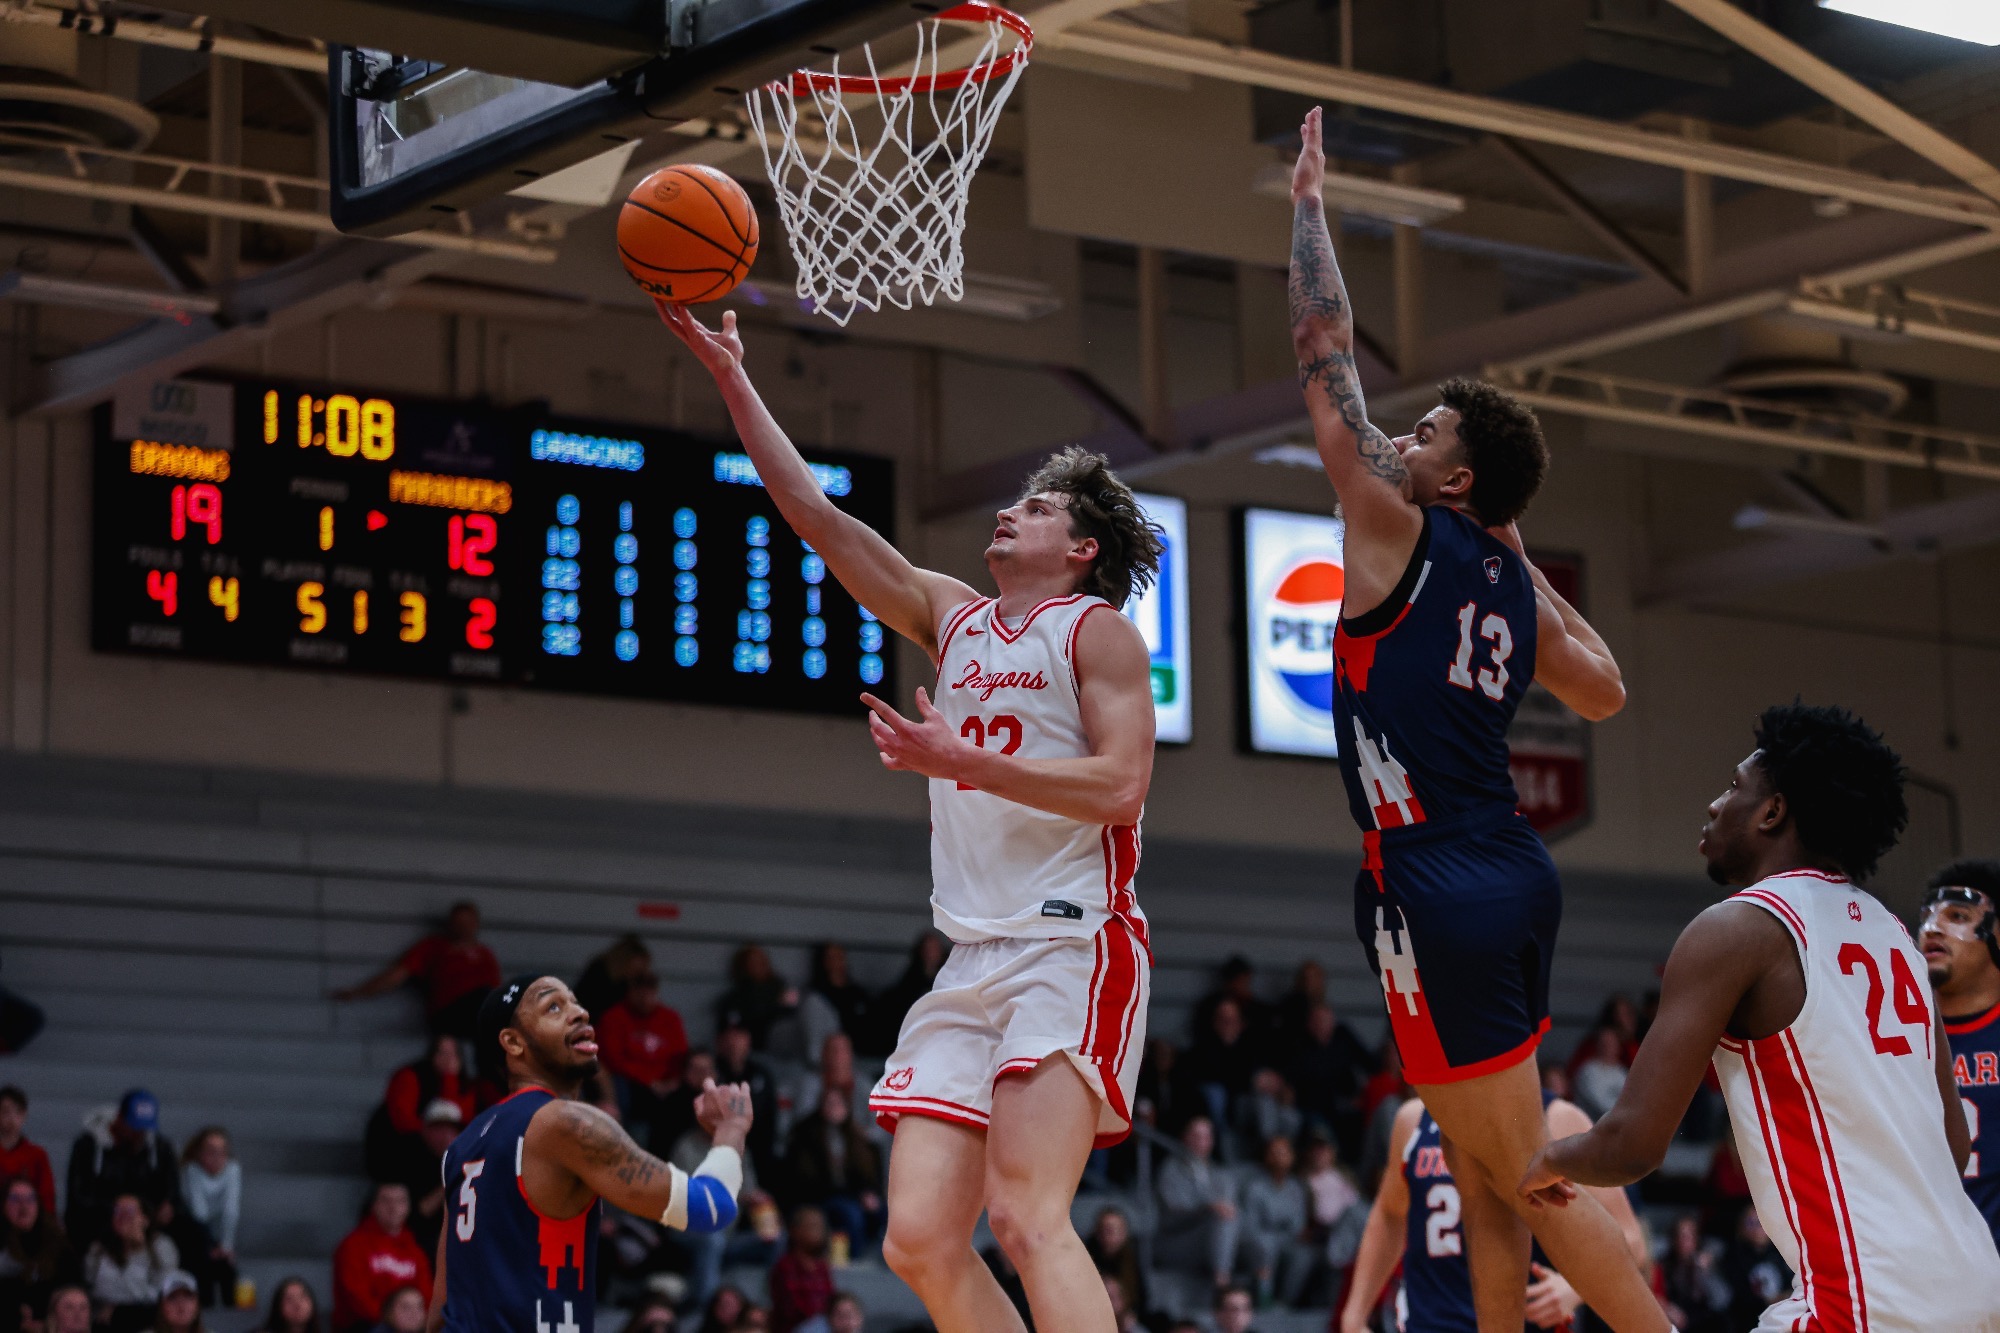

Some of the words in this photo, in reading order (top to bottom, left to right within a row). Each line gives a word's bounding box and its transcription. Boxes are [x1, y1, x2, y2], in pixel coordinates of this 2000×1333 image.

[264, 390, 395, 461] 11:08
[171, 483, 222, 544] 19
[320, 507, 334, 550] 1
[448, 513, 498, 576] 12
[147, 570, 177, 616] 4
[209, 576, 239, 622] 4
[297, 582, 326, 633] 5
[354, 590, 368, 634] 1
[400, 592, 426, 642] 3
[466, 598, 496, 649] 2
[952, 660, 1049, 702] Dragons
[1447, 600, 1513, 702] 13
[1837, 942, 1932, 1060] 24
[456, 1159, 486, 1243] 5
